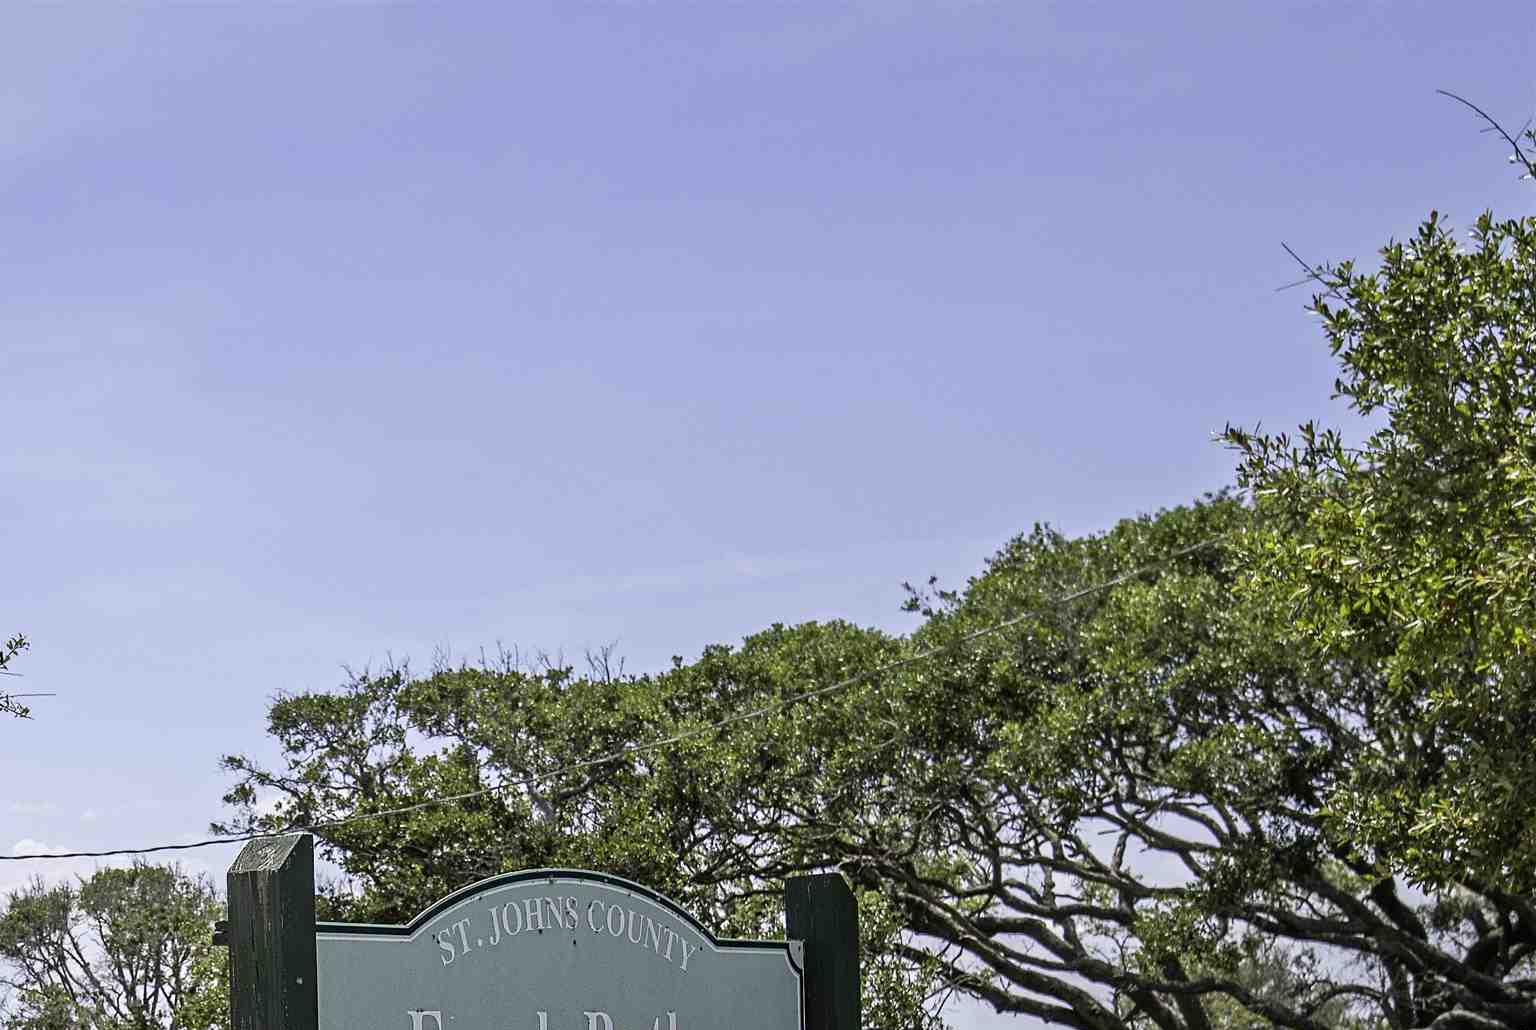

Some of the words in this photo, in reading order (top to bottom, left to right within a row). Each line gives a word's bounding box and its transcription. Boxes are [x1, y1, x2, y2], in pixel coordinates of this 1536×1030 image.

[437, 918, 483, 968] ST.
[488, 896, 578, 945] JOHNS
[588, 900, 696, 972] COUNTY
